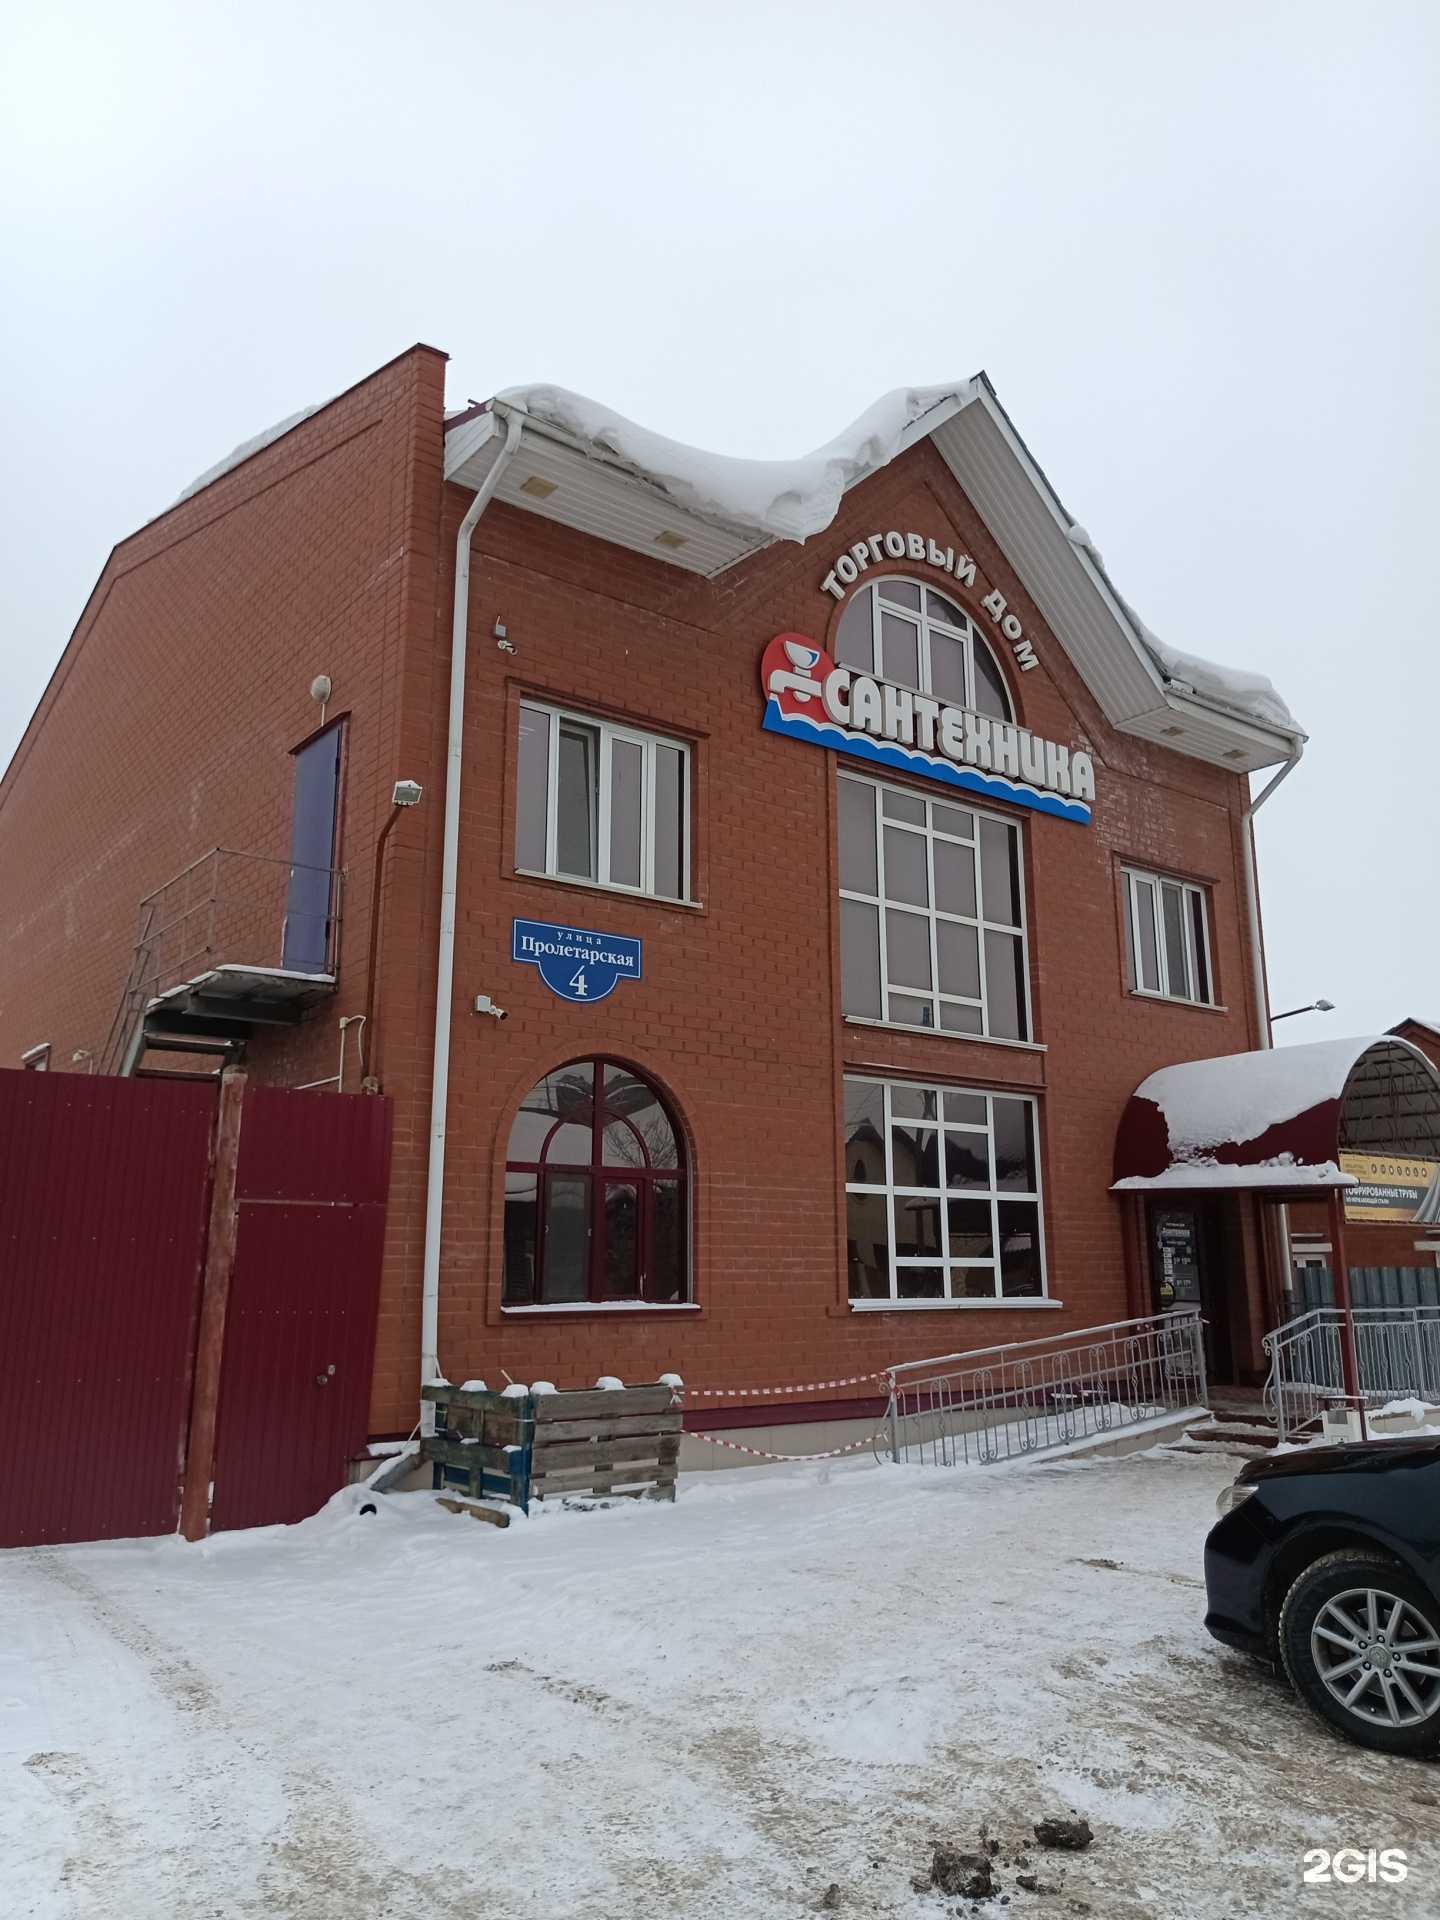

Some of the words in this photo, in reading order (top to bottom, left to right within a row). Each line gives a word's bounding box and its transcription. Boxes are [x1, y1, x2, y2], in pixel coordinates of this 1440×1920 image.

[820, 531, 978, 600] ТОРГОВЫЙ
[981, 588, 1039, 672] ДОМ
[821, 669, 1096, 801] САНТЕХНИКА
[521, 935, 634, 967] Пролетарская
[557, 931, 601, 945] улица
[569, 965, 588, 996] 4
